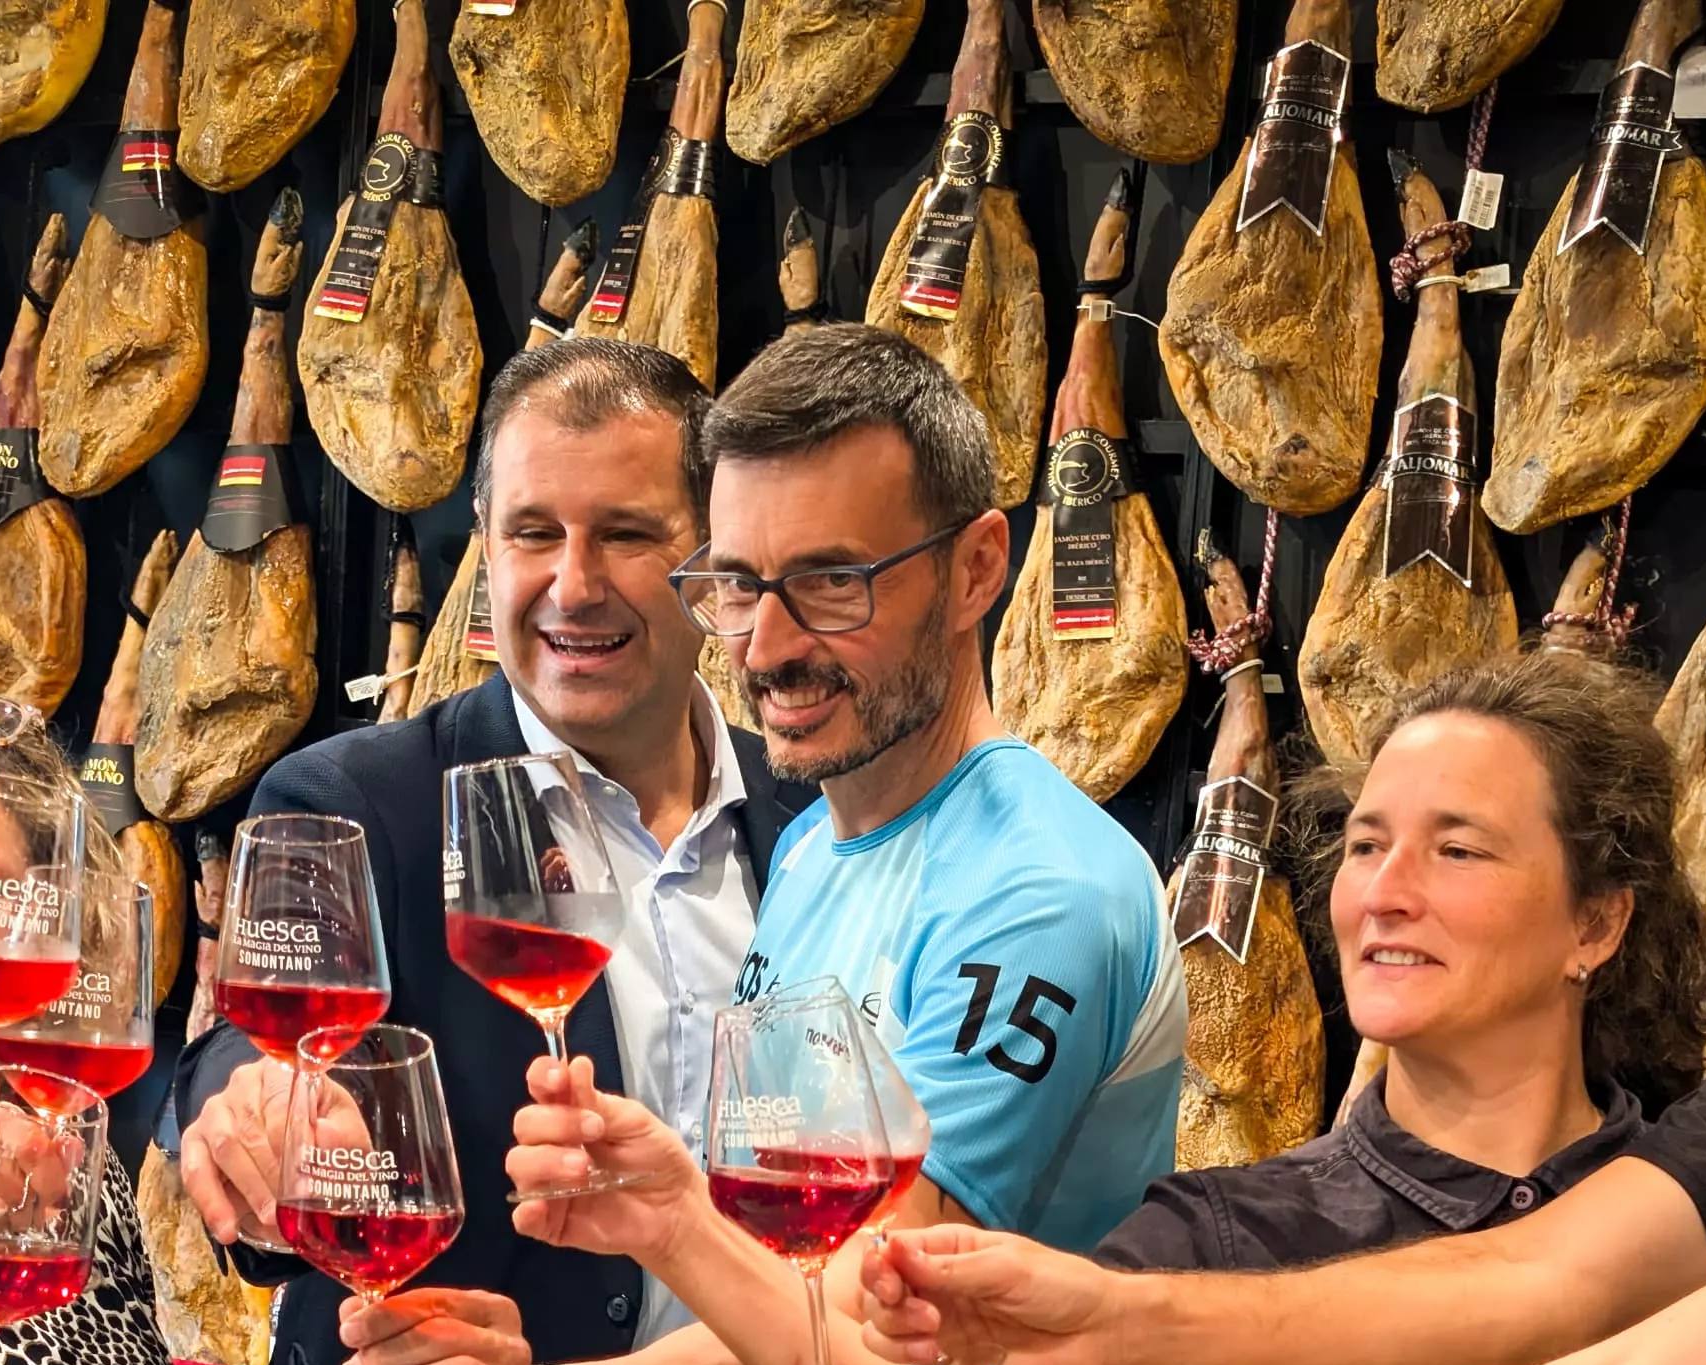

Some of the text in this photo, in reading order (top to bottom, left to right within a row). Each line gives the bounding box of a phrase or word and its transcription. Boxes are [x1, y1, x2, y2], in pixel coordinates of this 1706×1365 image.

[1263, 103, 1335, 128] ALJOMAR
[1601, 124, 1662, 146] LJOMAR
[1397, 456, 1470, 479] ALJOMAR
[1062, 491, 1103, 507] IBÉRICO
[1193, 835, 1261, 862] ALJOMAR
[234, 916, 321, 943] Huesca
[238, 949, 313, 971] SOMONTANO
[951, 962, 1078, 1084] 15
[301, 1144, 398, 1171] Huesca
[307, 1178, 391, 1201] SOMONTANO
